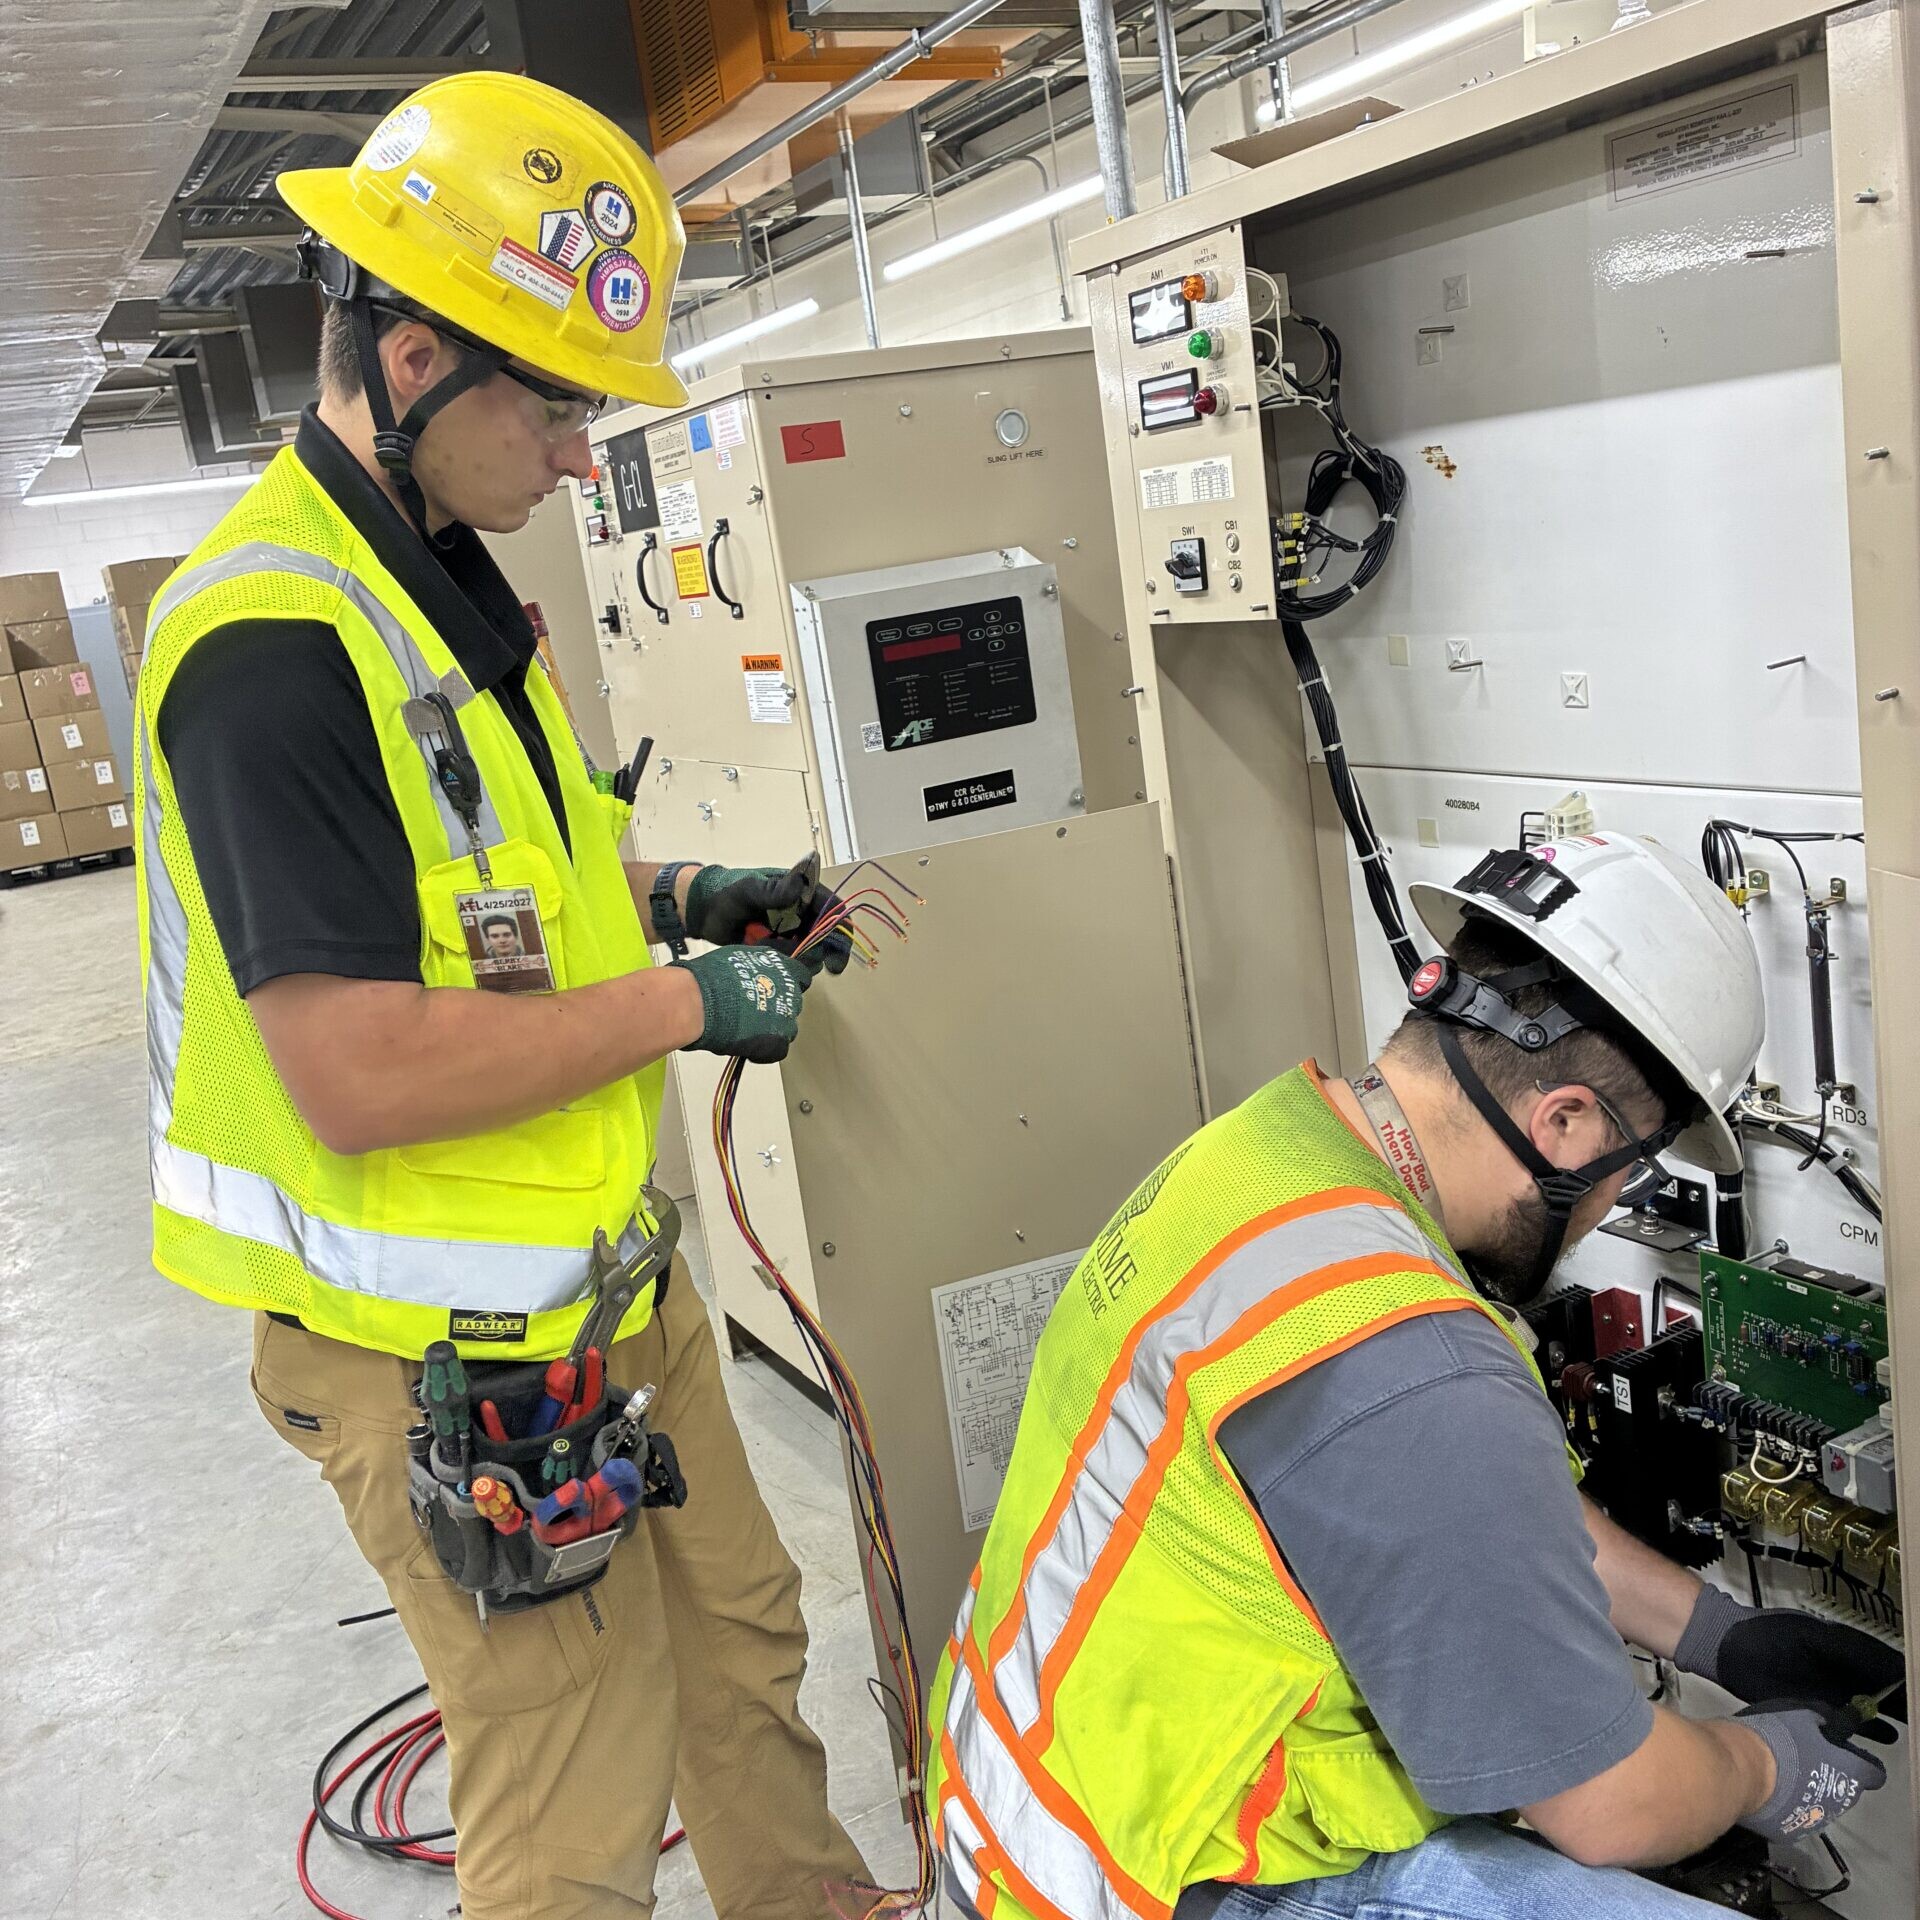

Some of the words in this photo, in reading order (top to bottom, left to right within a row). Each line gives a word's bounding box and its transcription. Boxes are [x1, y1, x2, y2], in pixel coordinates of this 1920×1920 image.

[600, 213, 619, 230] 2024
[588, 218, 622, 245] AWARENESS
[500, 260, 515, 272] CALL
[628, 260, 649, 285] SAFETY
[1150, 269, 1164, 281] AM1
[601, 310, 641, 330] ORIENTATION
[1160, 361, 1174, 371] VM1
[800, 427, 815, 455] S
[987, 454, 1007, 464] SLING
[1009, 452, 1023, 461] LIFT
[1026, 449, 1044, 458] HERE
[1181, 526, 1195, 536] SW1
[1224, 520, 1238, 530] CB1
[1228, 560, 1242, 570] CB2
[751, 659, 780, 670] WARNING
[935, 801, 949, 811] TWY
[970, 788, 1007, 804] CENTERLINE
[954, 787, 967, 798] CCR
[970, 784, 985, 794] G-CL
[484, 897, 531, 909] 4/25/2027
[1832, 1105, 1867, 1126] RD3
[1380, 1121, 1403, 1162] Them
[1397, 1128, 1418, 1161] How
[1840, 1222, 1878, 1247] CPM
[1082, 1256, 1107, 1321] ELECTRIC
[457, 1321, 516, 1329] RADWEAR
[1615, 1378, 1629, 1406] TS1
